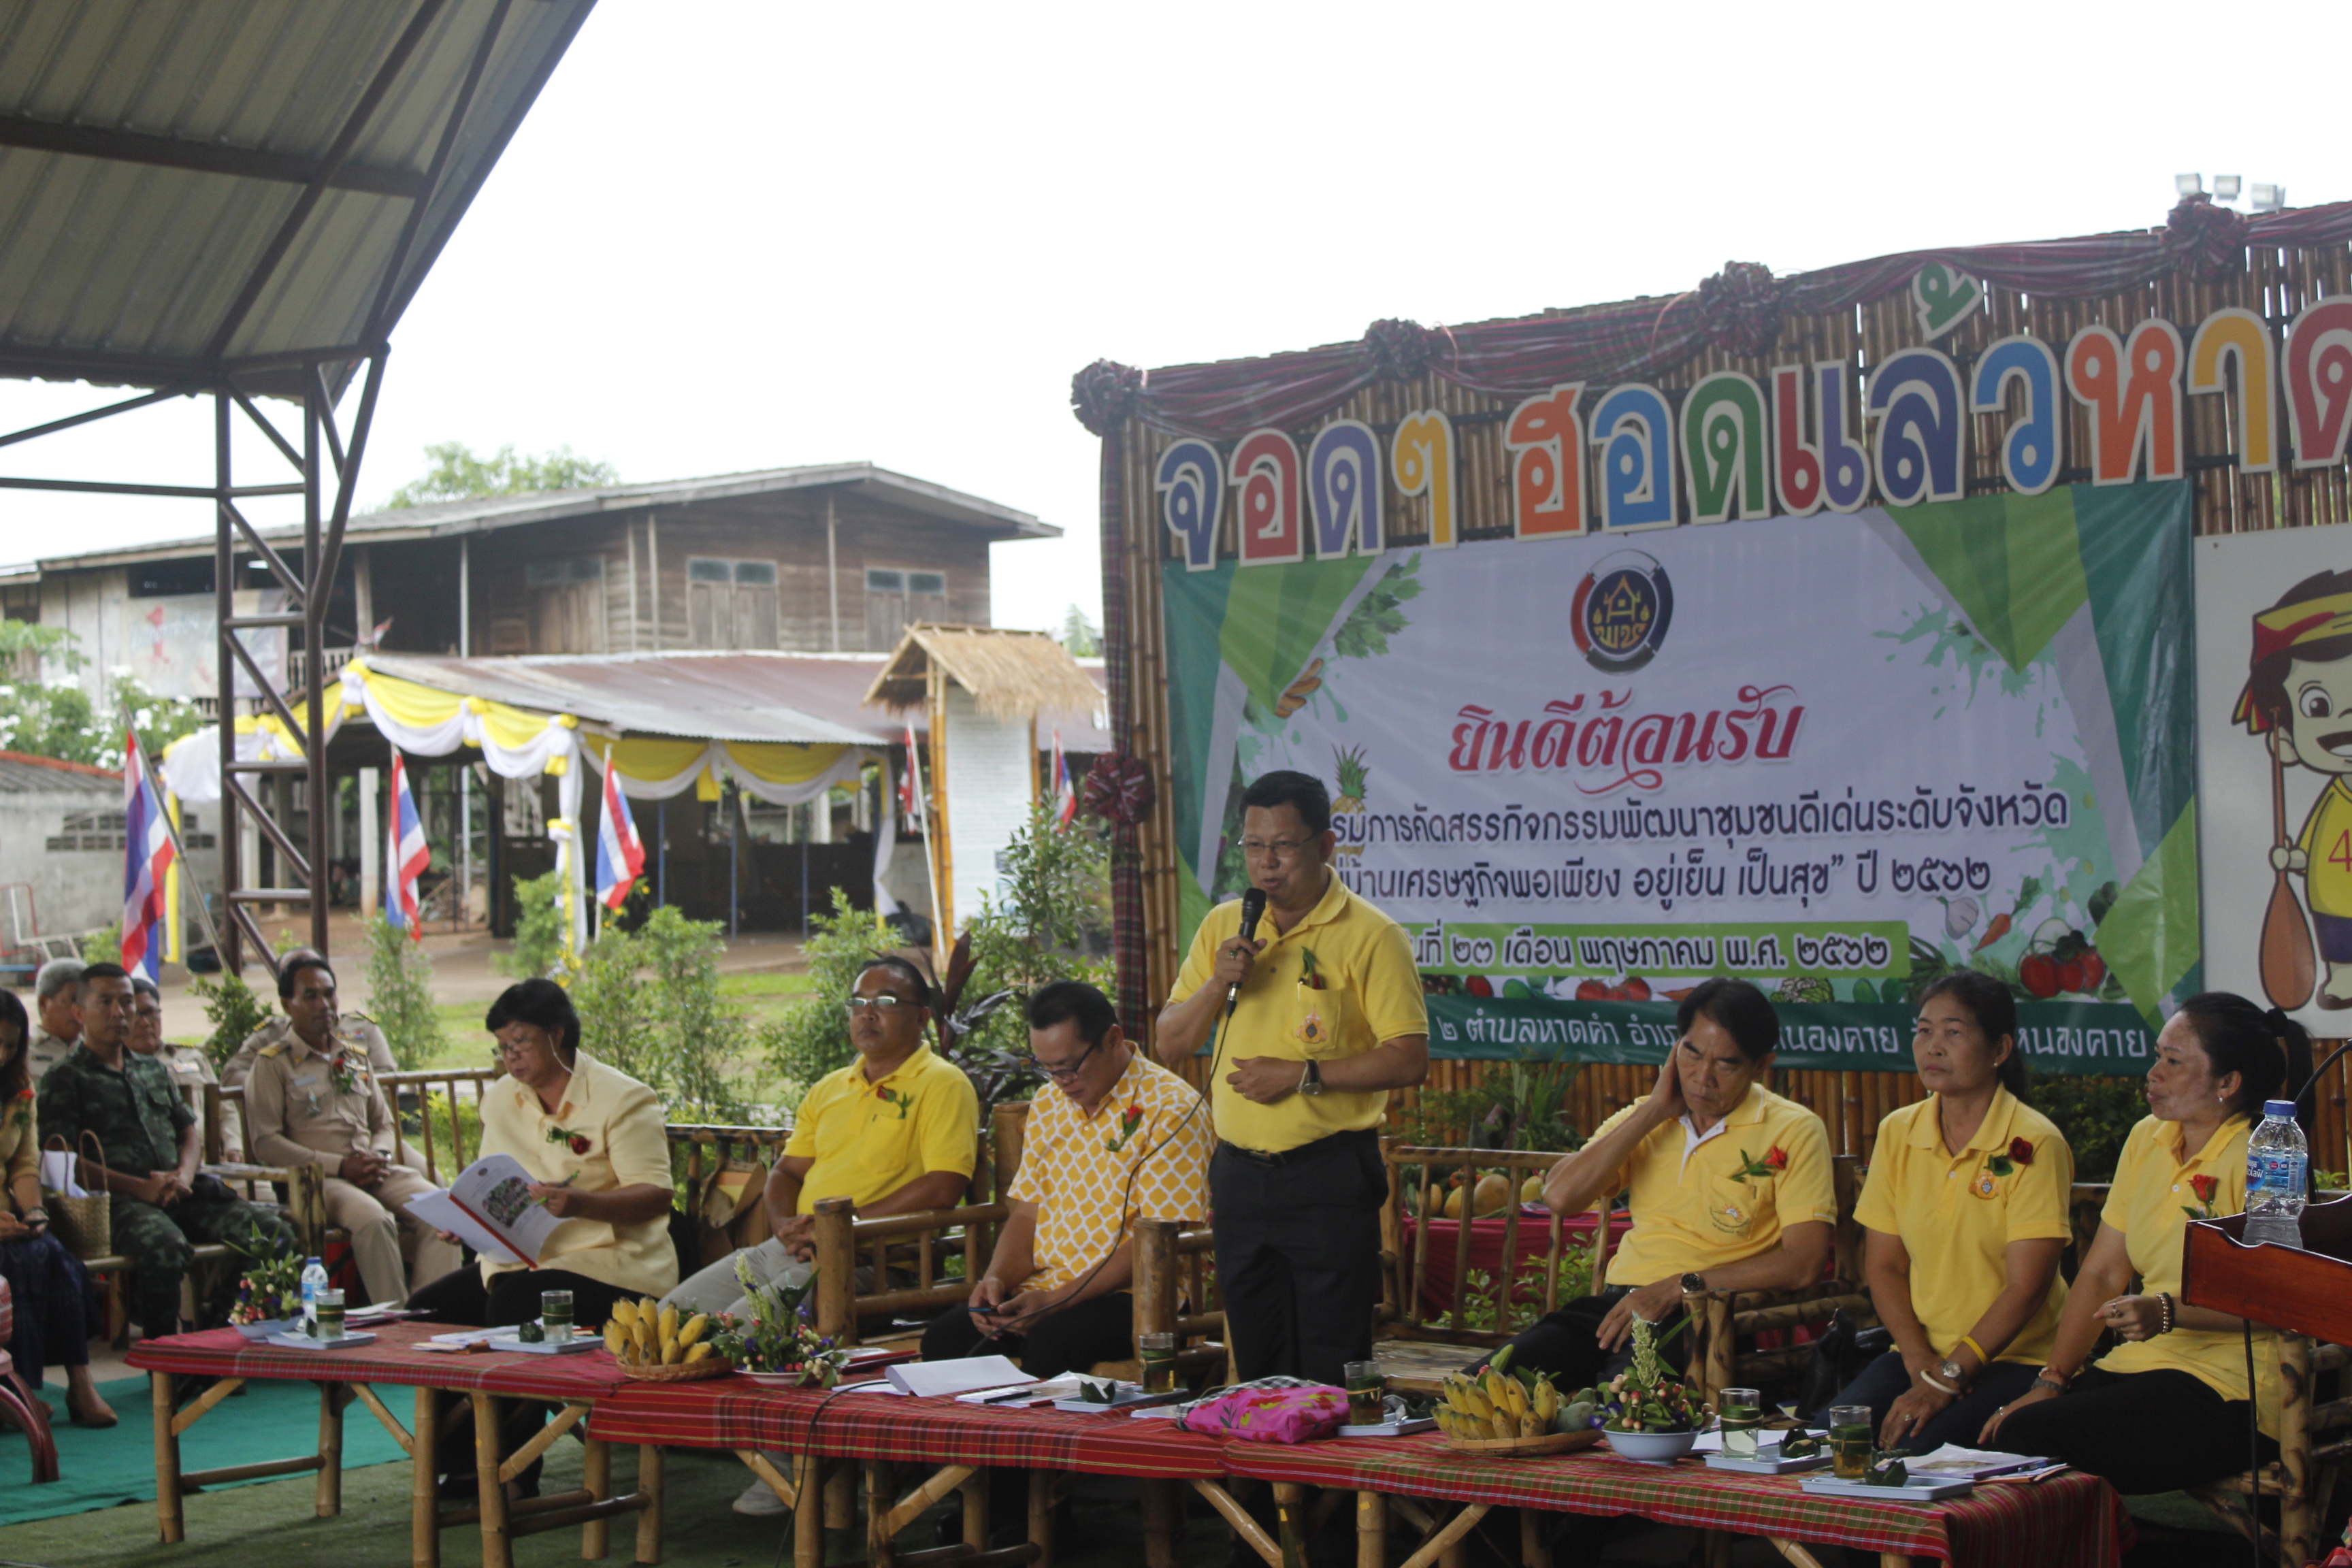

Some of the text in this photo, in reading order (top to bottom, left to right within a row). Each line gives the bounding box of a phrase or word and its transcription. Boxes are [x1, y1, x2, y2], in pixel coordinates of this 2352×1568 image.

[1448, 684, 1805, 794] ยินดีต้อนรับ
[1633, 848, 1725, 911] อยู่เย็น
[1856, 849, 1878, 893] ปี
[1892, 856, 1991, 893] ๒๕๖๒
[1504, 928, 1572, 965] เดือน
[1580, 940, 1714, 973] พฤษภาคม
[1725, 938, 1786, 966] พ.ศ.
[1796, 936, 1888, 966] ๒๕๖๒
[1465, 1007, 1620, 1045] ตำบลหาดคำ
